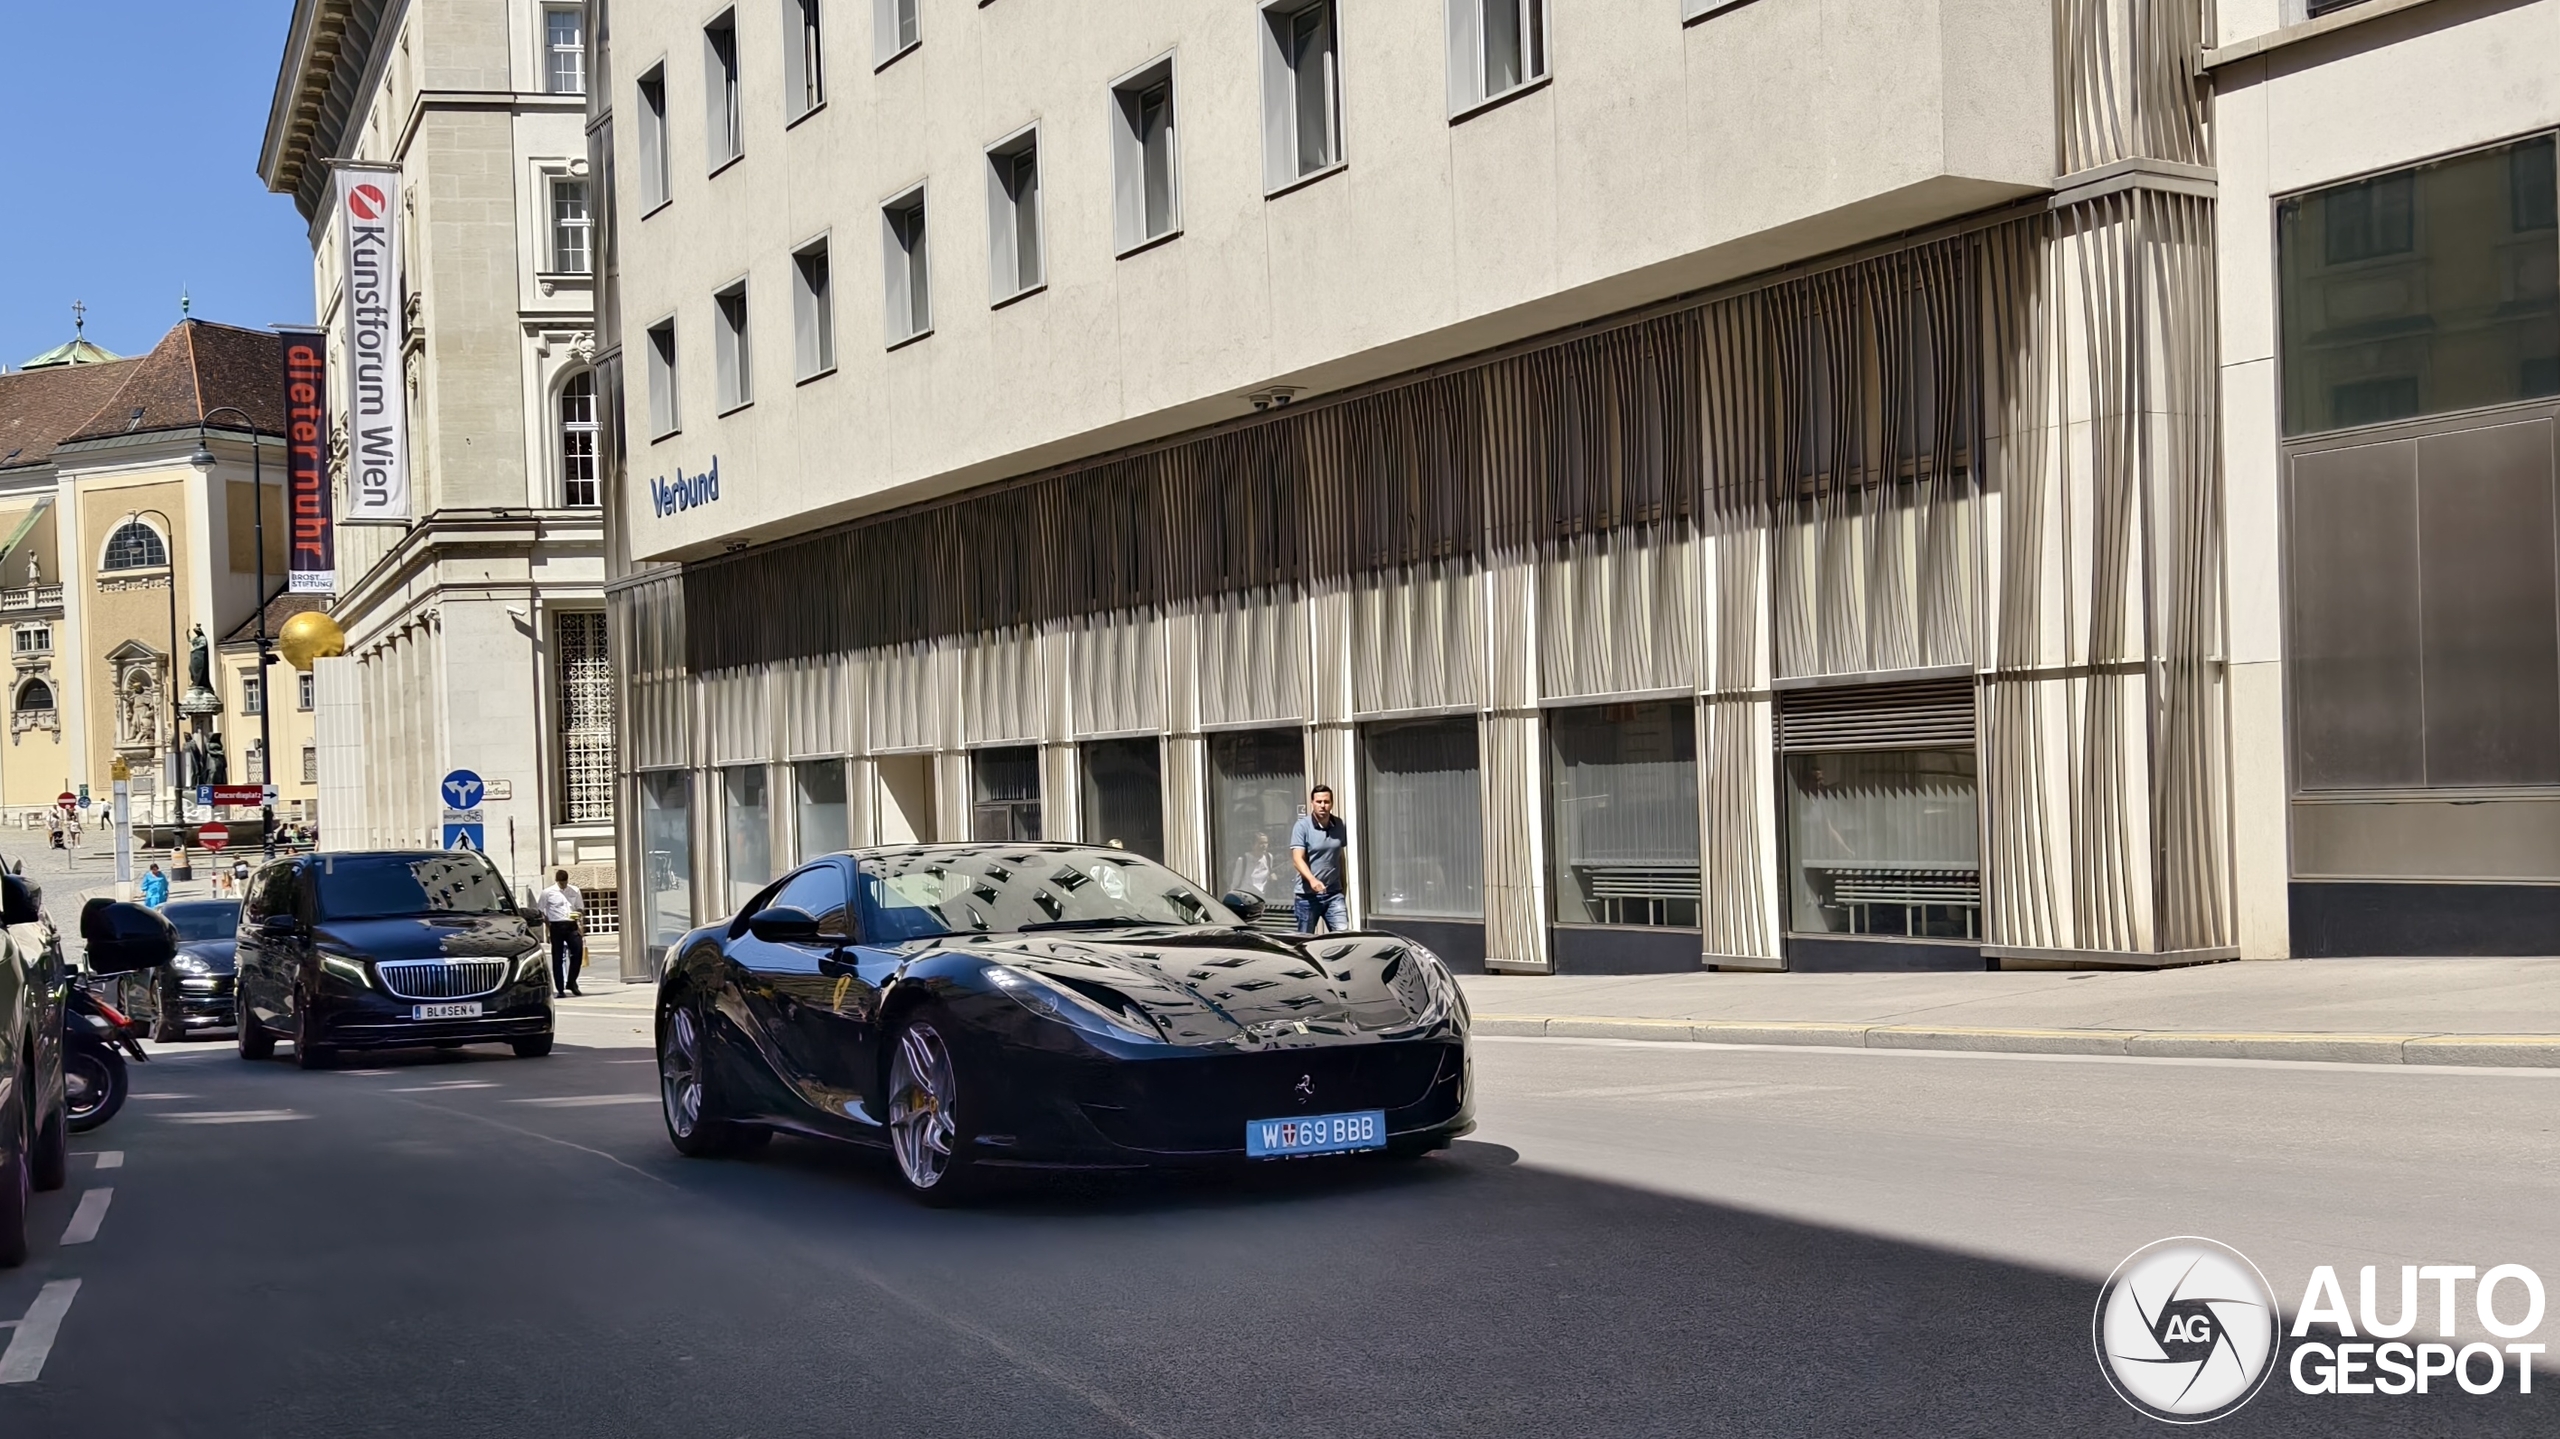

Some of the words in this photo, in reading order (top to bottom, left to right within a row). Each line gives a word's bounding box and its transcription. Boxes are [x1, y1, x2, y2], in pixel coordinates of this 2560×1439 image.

[352, 226, 389, 415] Kunstforum
[288, 345, 323, 460] dieter
[360, 425, 394, 507] Wien
[650, 454, 719, 519] Verbund
[294, 469, 328, 558] nuhr
[291, 573, 320, 581] BROST
[291, 580, 333, 588] STIFTUNG
[201, 788, 210, 798] P
[427, 1007, 439, 1017] BL
[447, 1005, 467, 1016] SEN
[1262, 1123, 1279, 1149] W
[1299, 1120, 1327, 1146] 69
[1333, 1116, 1374, 1143] BBB
